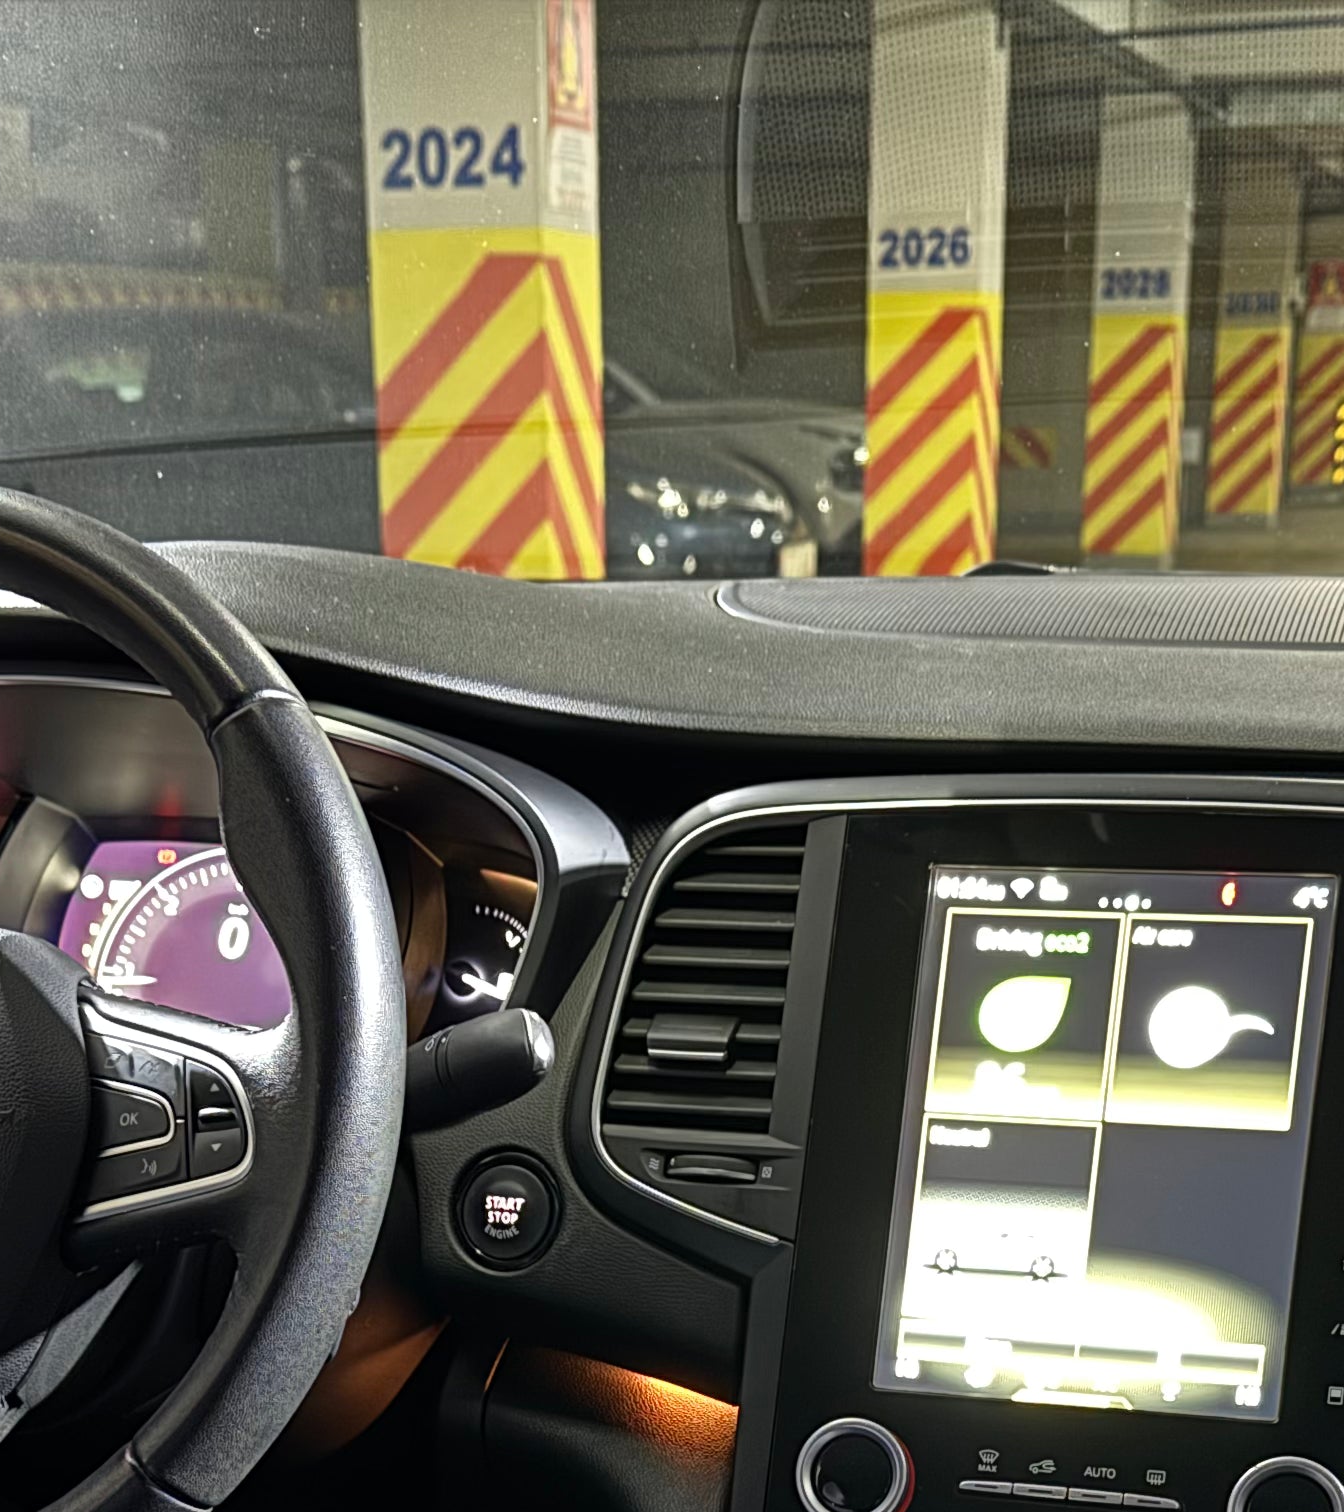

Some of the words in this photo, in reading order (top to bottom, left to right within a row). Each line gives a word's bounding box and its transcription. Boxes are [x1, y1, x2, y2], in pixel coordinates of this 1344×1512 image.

[381, 125, 525, 189] 2024
[878, 227, 971, 268] 2026
[218, 917, 250, 960] 0
[119, 1112, 139, 1126] OK
[485, 1195, 526, 1212] START
[487, 1211, 519, 1225] STOP
[484, 1223, 520, 1240] ENGINE
[977, 1463, 997, 1473] MAX
[1083, 1466, 1116, 1479] AUTO
